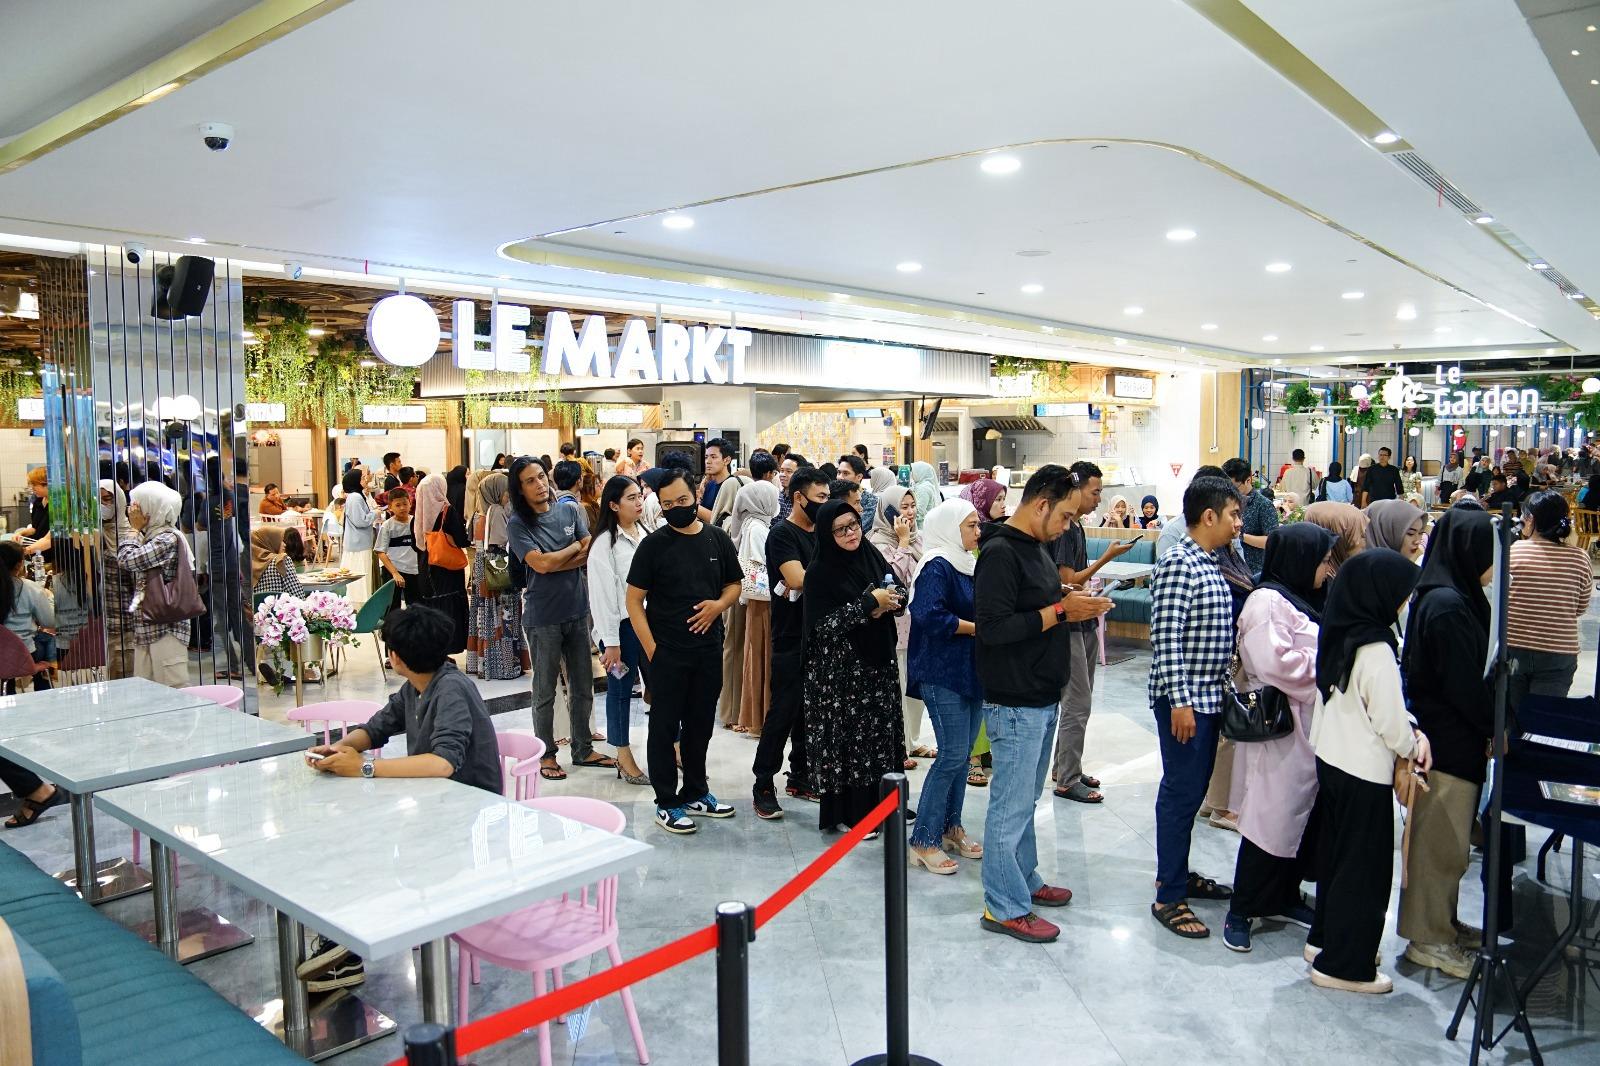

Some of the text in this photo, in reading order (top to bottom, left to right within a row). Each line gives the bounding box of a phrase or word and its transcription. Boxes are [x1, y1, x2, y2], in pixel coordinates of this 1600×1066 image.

[452, 301, 752, 385] LE MARKT
[1436, 365, 1460, 385] Le
[1434, 385, 1539, 415] Garden
